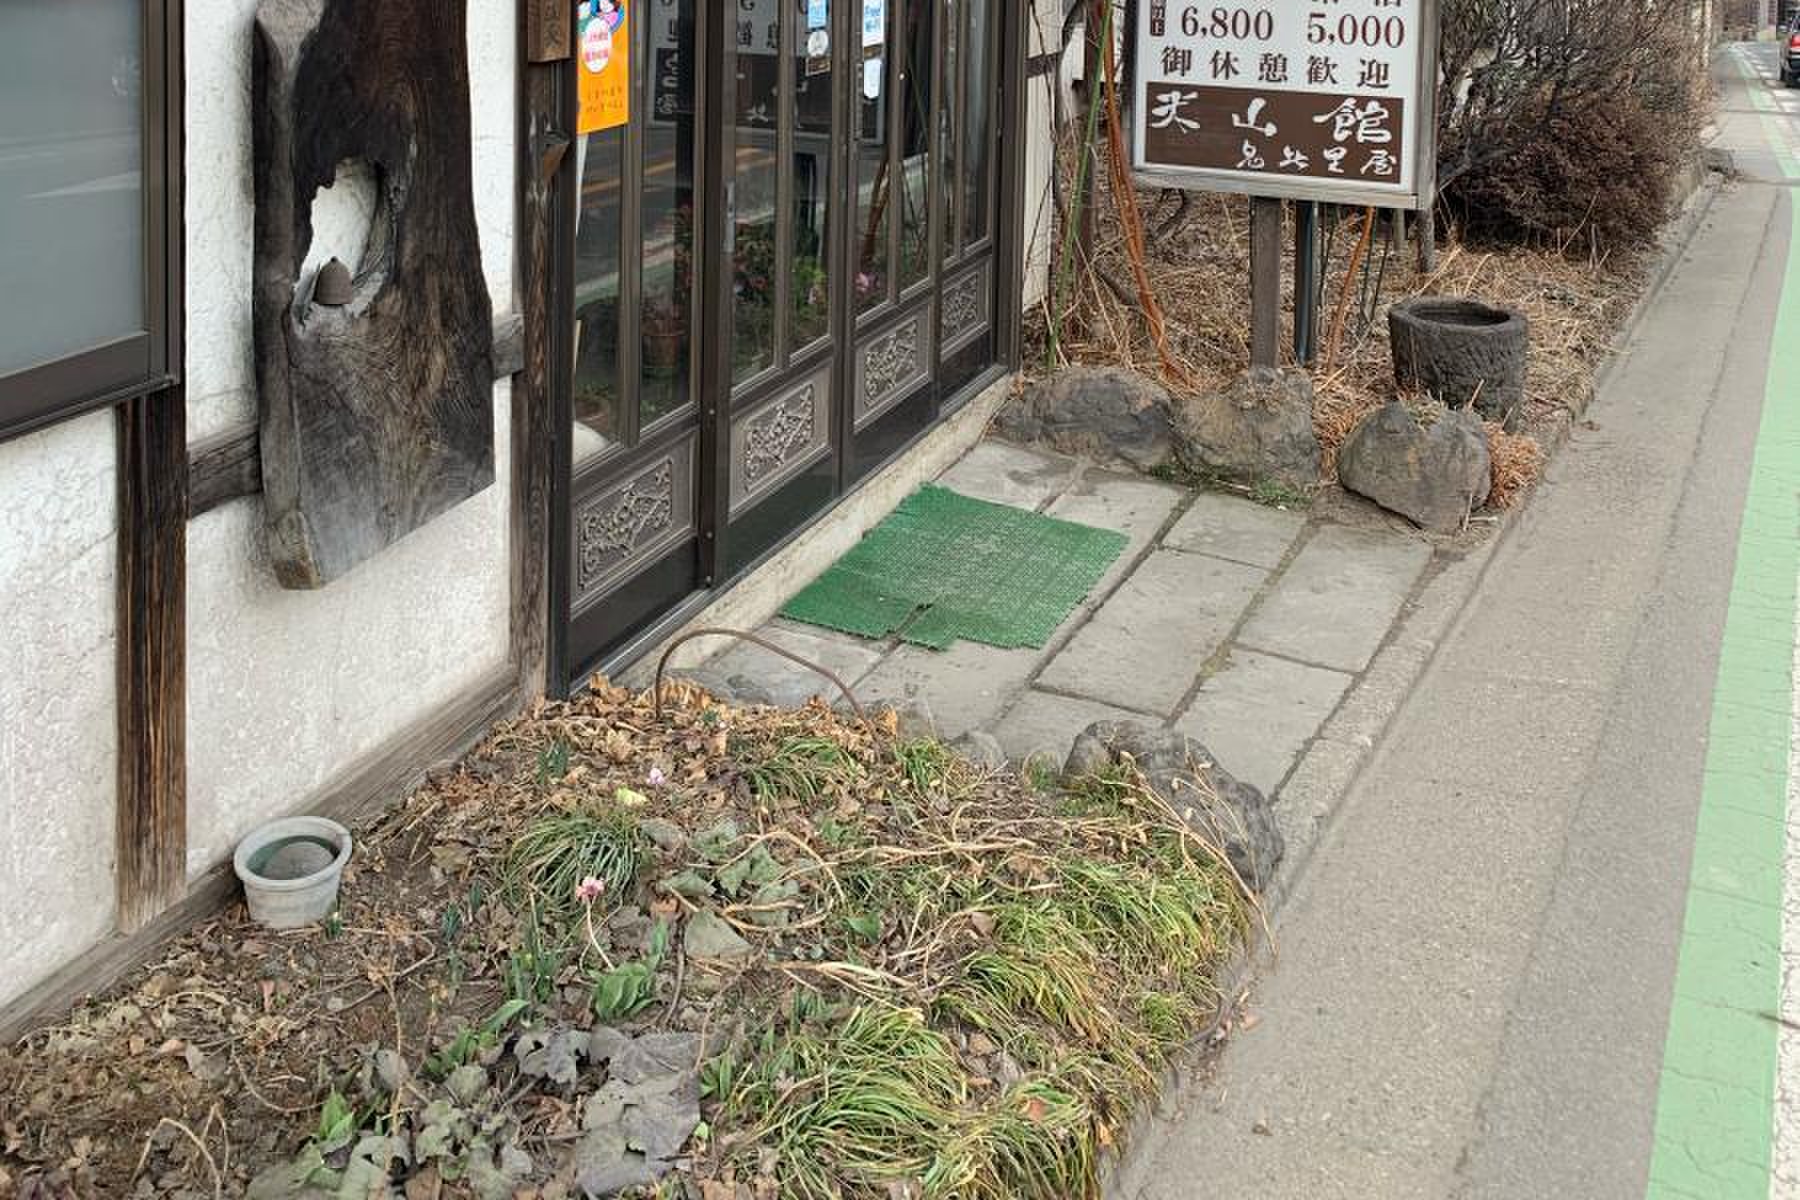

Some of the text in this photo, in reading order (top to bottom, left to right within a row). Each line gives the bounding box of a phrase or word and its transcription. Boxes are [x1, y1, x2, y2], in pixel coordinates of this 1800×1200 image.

[1181, 7, 1405, 48] 6,800 5,000
[1161, 46, 1391, 88] 御休憩歓迎
[1151, 90, 1393, 143] 天山館
